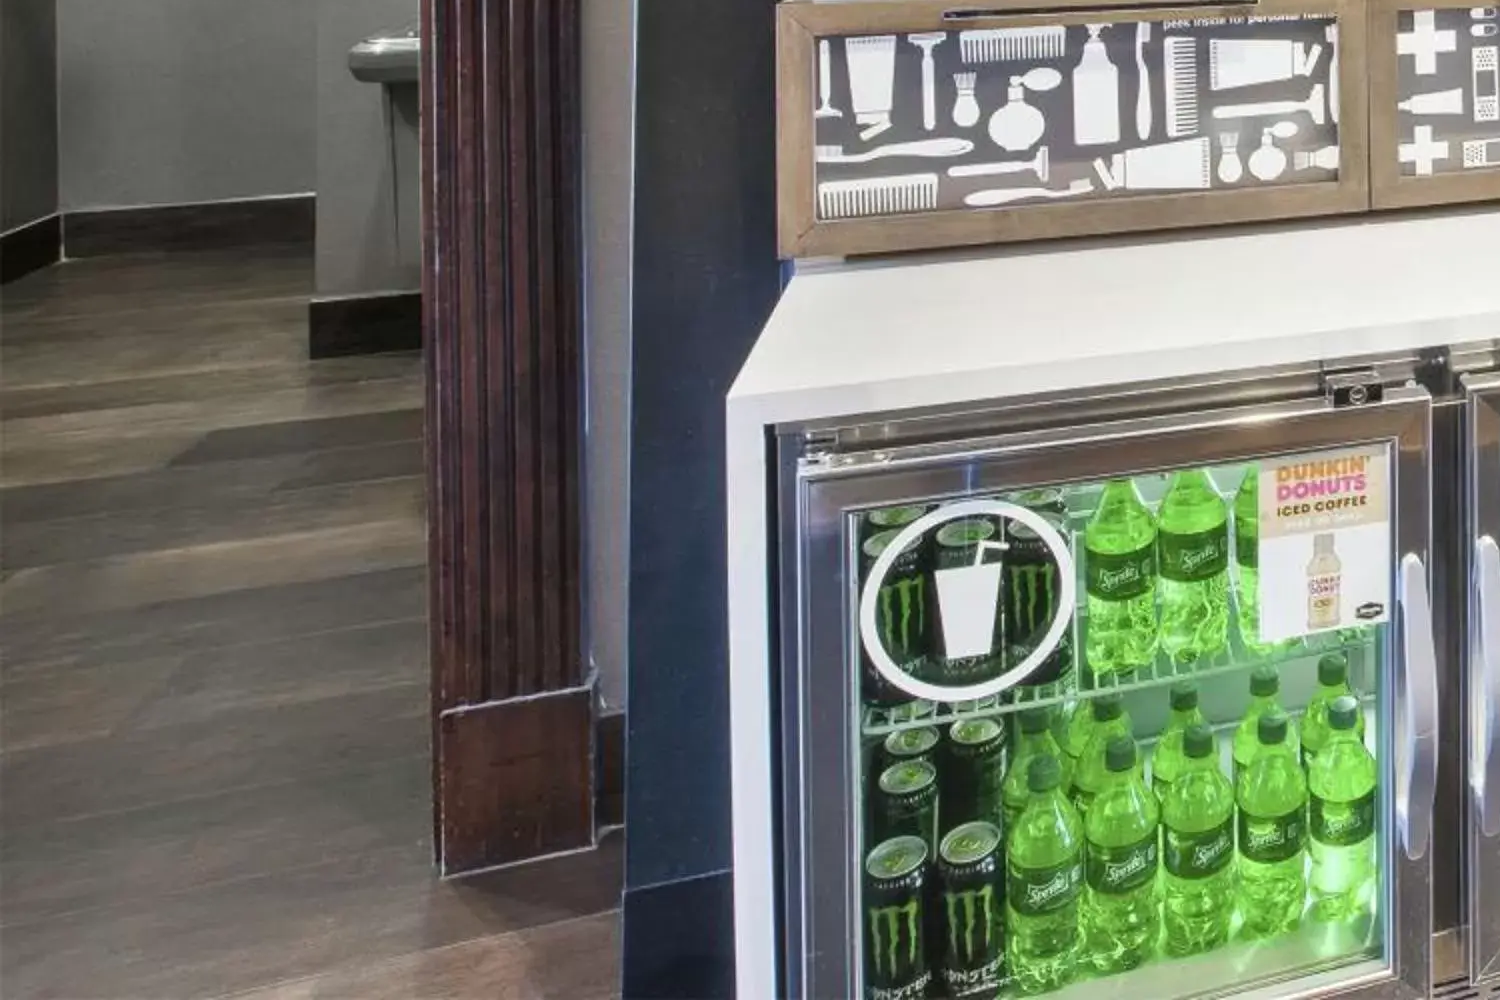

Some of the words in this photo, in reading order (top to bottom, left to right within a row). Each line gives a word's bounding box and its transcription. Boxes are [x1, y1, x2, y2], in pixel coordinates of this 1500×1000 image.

[1276, 456, 1371, 482] DUNKIN'
[1276, 474, 1368, 502] DONUTS
[1277, 504, 1311, 518] ICED
[1314, 495, 1368, 512] COFFEE
